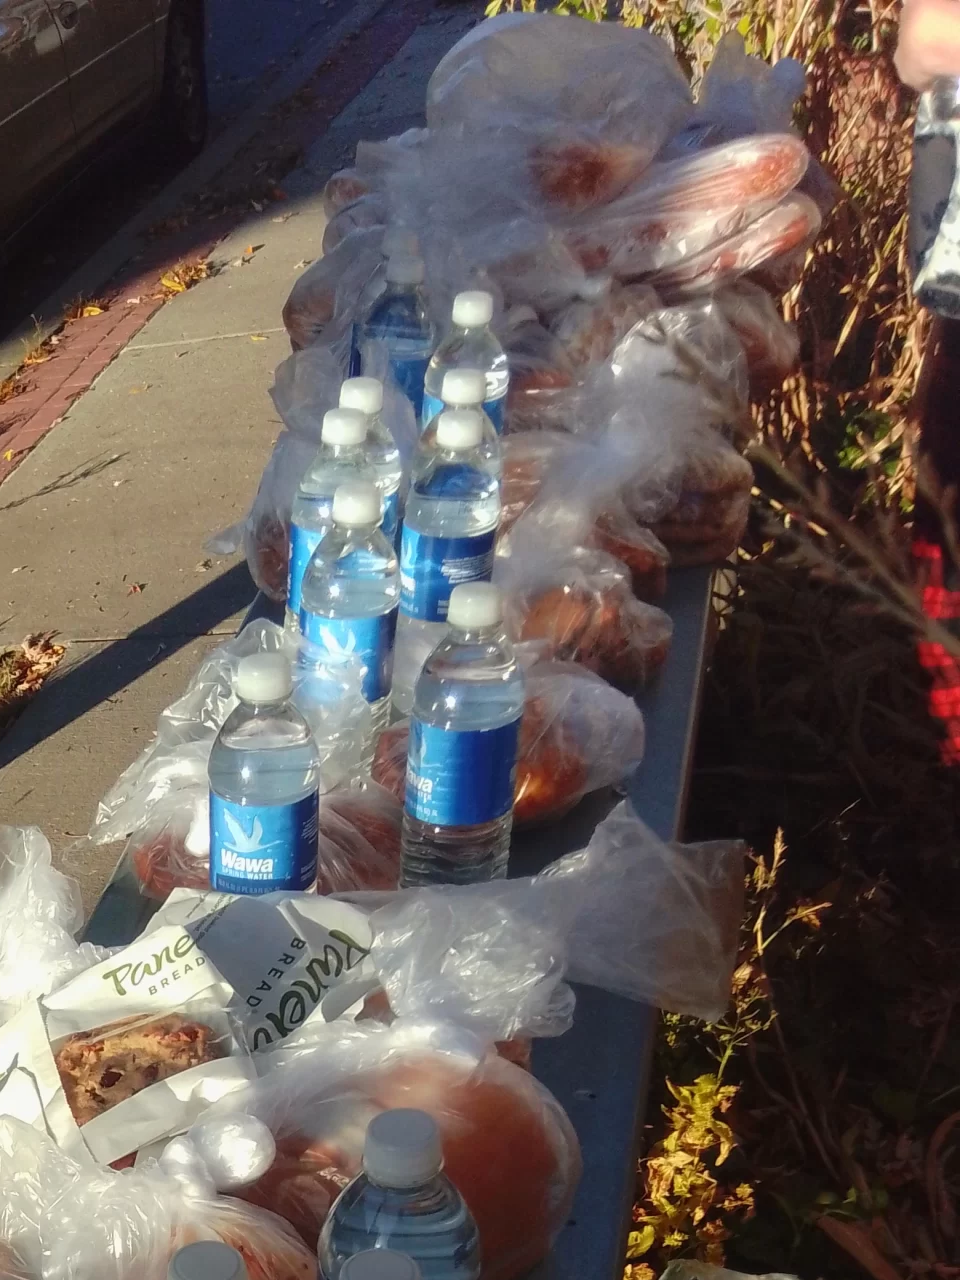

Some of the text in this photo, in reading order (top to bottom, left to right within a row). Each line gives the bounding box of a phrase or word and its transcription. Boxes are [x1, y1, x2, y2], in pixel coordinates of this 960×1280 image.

[221, 848, 274, 873] Wawa
[102, 934, 196, 996] Pane
[147, 956, 206, 996] BREAD
[246, 937, 307, 1008] BREAD
